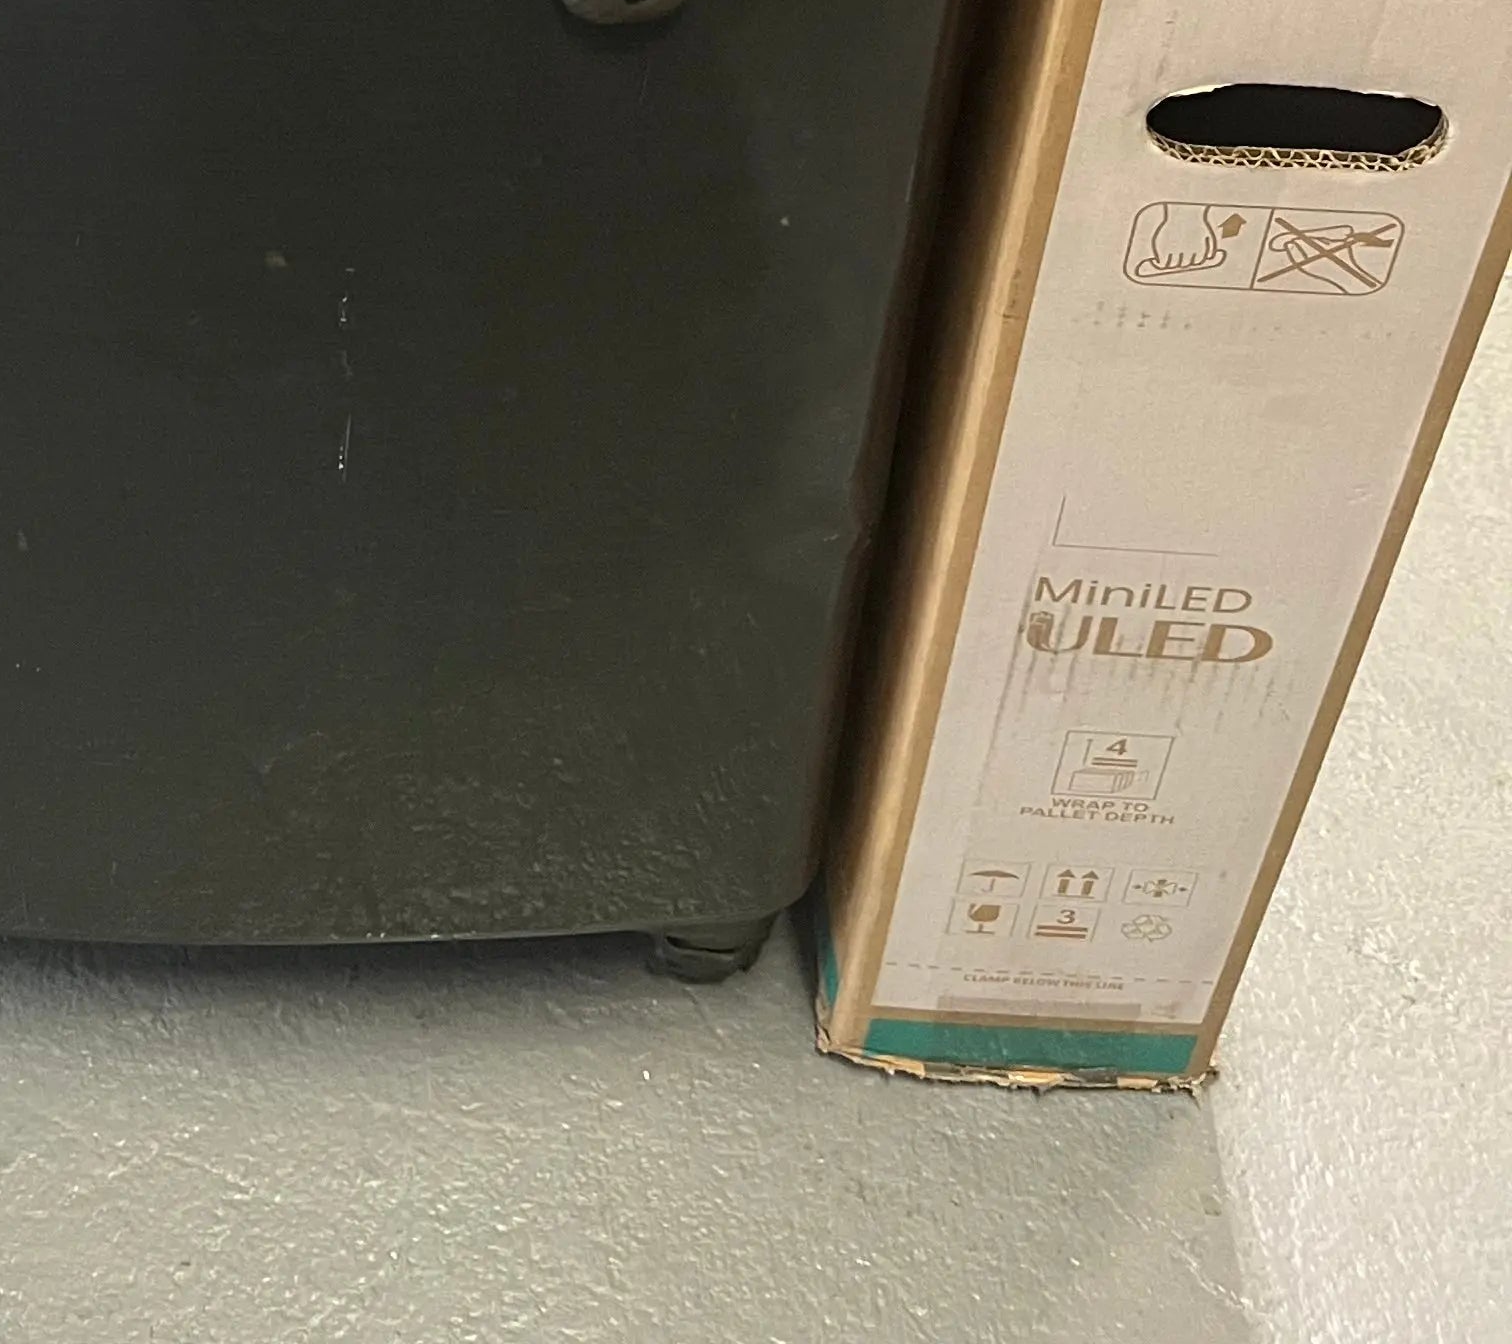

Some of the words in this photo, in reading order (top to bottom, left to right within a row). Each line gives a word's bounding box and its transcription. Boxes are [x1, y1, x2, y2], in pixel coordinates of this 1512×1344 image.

[1034, 576, 1253, 613] MiniLED
[1026, 612, 1274, 664] ULED
[1105, 738, 1129, 756] 4
[1052, 798, 1116, 811] WRAP
[1123, 802, 1150, 813] TO
[1020, 806, 1099, 820] PALLET
[1105, 812, 1176, 825] DEPTH
[1056, 909, 1077, 925] 3
[964, 973, 1010, 983] CLAMP
[1013, 977, 1061, 987] BELOW
